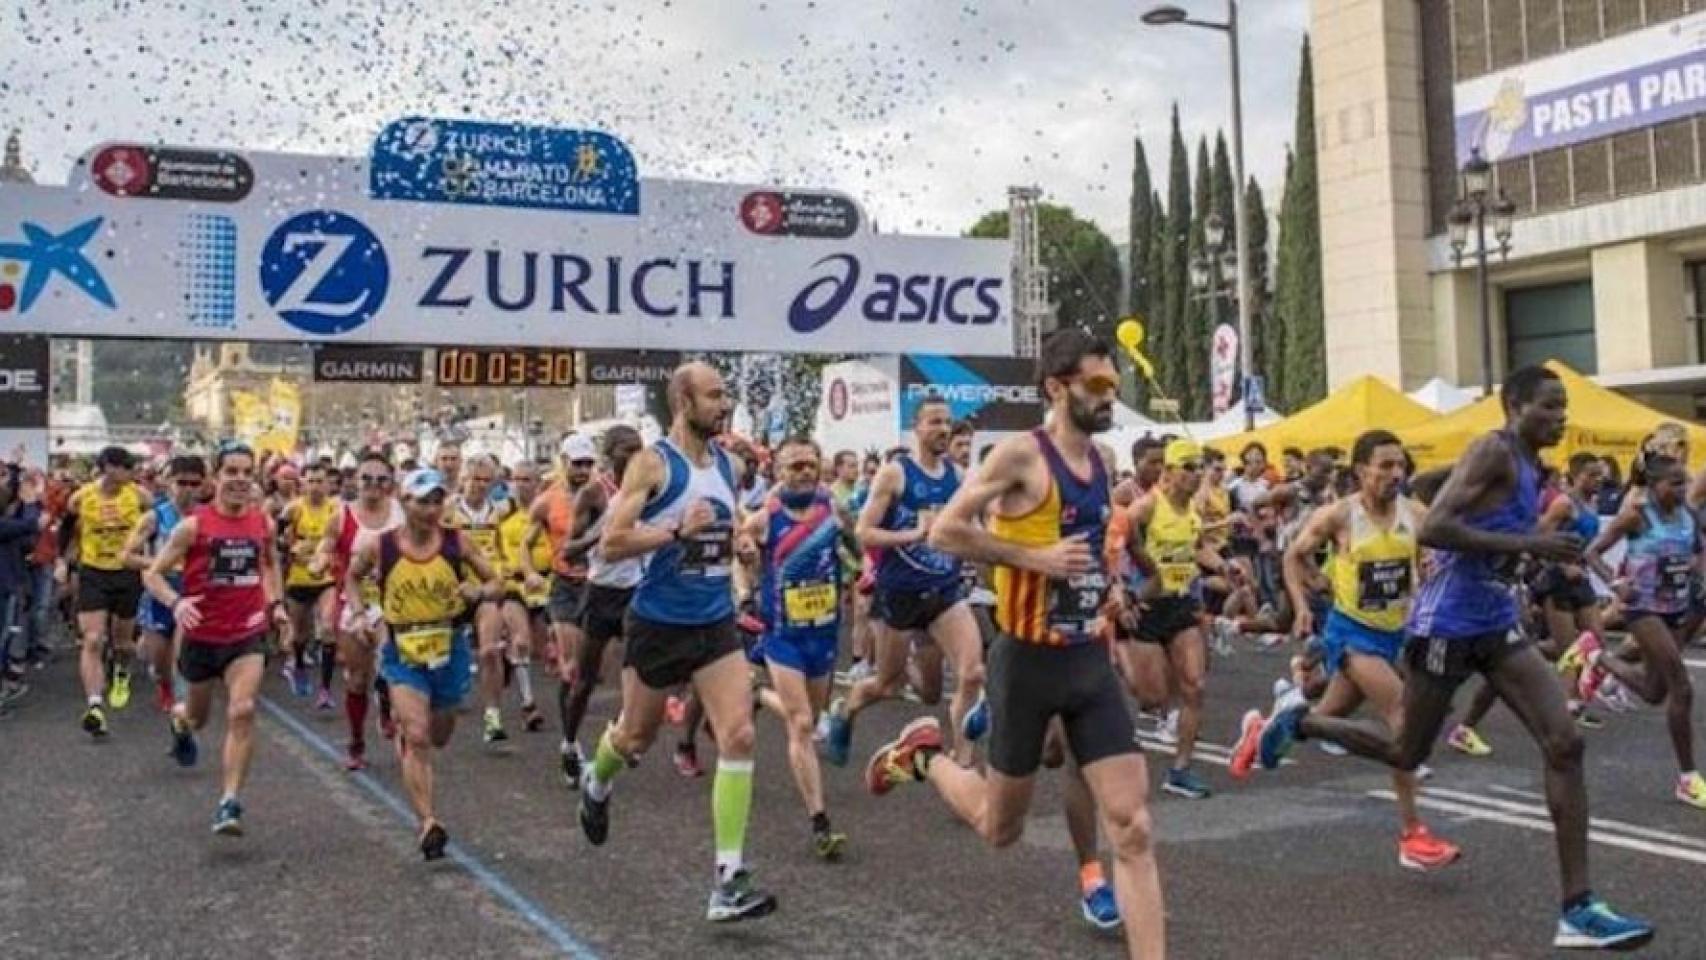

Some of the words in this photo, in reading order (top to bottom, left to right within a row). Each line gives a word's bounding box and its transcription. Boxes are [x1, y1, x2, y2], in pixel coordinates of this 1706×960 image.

[1532, 81, 1634, 138] PASTA
[1639, 63, 1706, 110] PAR
[445, 131, 531, 155] ZURICH
[417, 246, 736, 318] ZURICH
[320, 360, 416, 379] GARMIN
